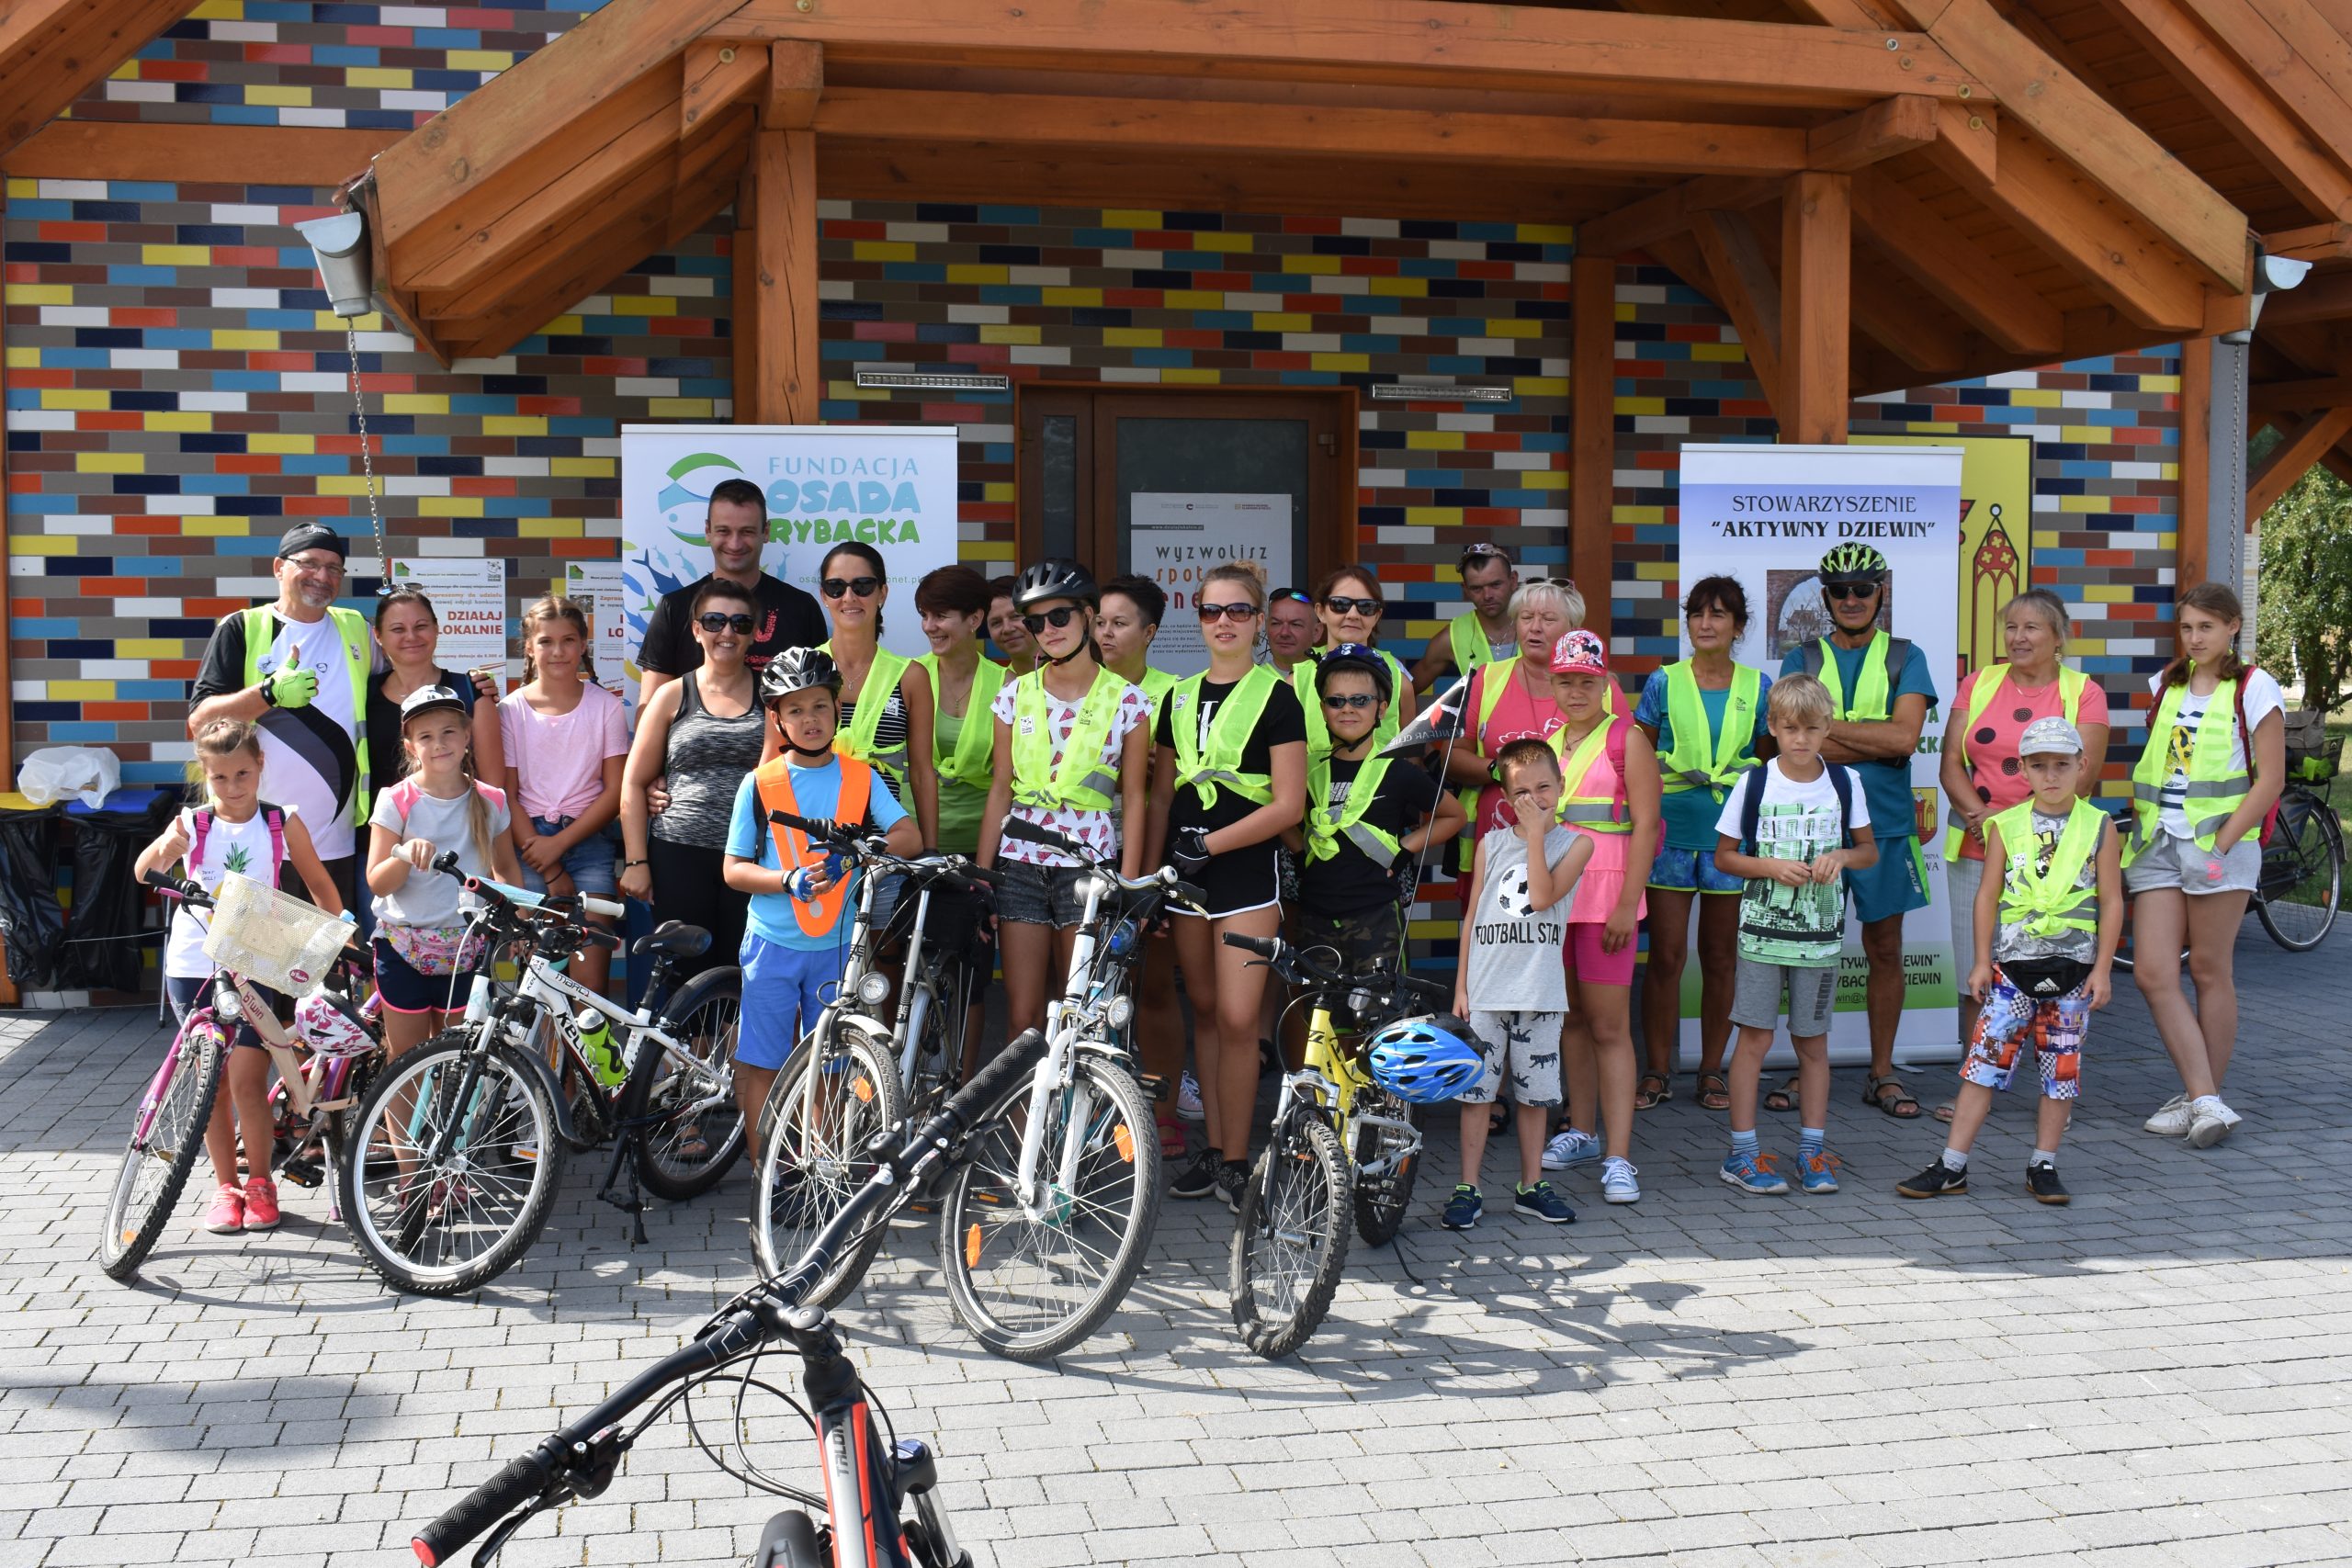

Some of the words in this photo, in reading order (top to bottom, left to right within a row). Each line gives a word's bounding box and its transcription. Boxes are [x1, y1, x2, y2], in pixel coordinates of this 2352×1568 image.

[769, 457, 919, 479] FUNDACJA
[765, 479, 922, 514] OSADA
[1732, 495, 1917, 513] STOWARZYSZENIE
[769, 518, 921, 545] RYBACKA
[1156, 544, 1267, 563] wyzwolisz
[447, 611, 503, 621] DZIAŁAJ
[437, 625, 503, 635] LOKALNIE
[1475, 921, 1535, 945] FOOTBALL
[1538, 922, 1561, 946] STA
